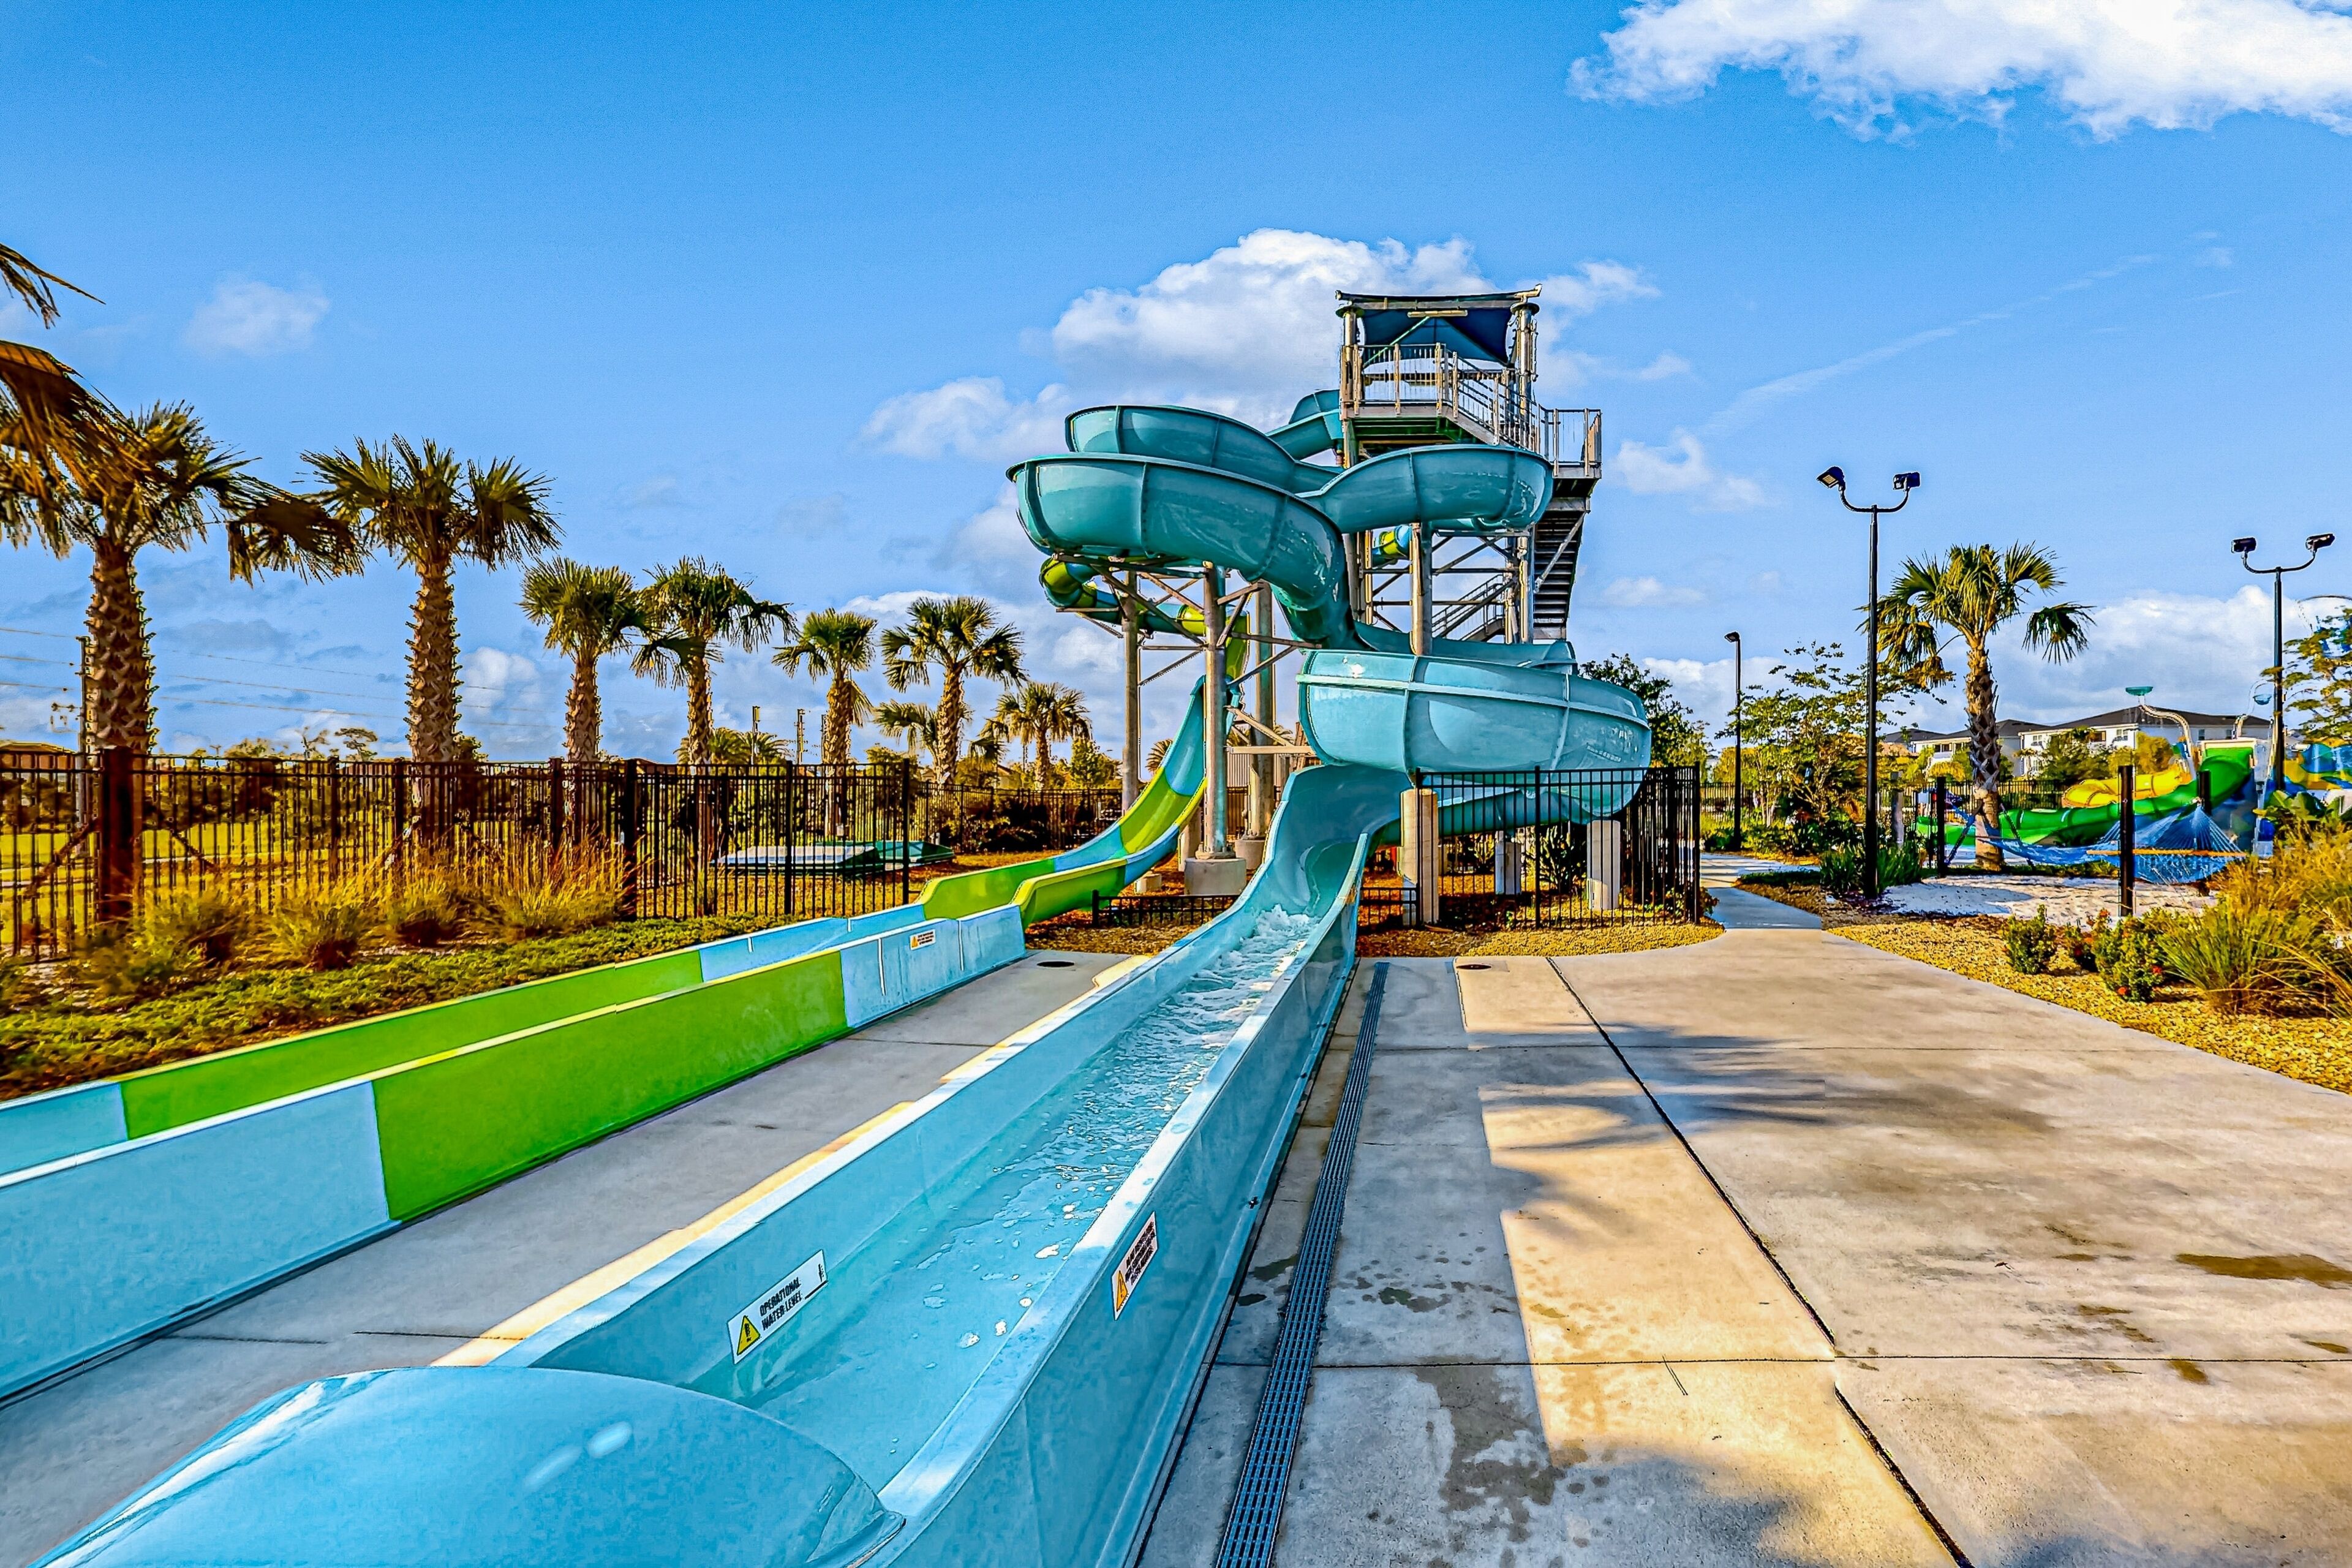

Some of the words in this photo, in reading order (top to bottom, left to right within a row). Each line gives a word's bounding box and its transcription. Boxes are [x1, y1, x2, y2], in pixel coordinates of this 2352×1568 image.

[760, 1277, 801, 1316] OPERATIONAL
[761, 1305, 785, 1330] WATER
[785, 1291, 802, 1311] LEVEL
